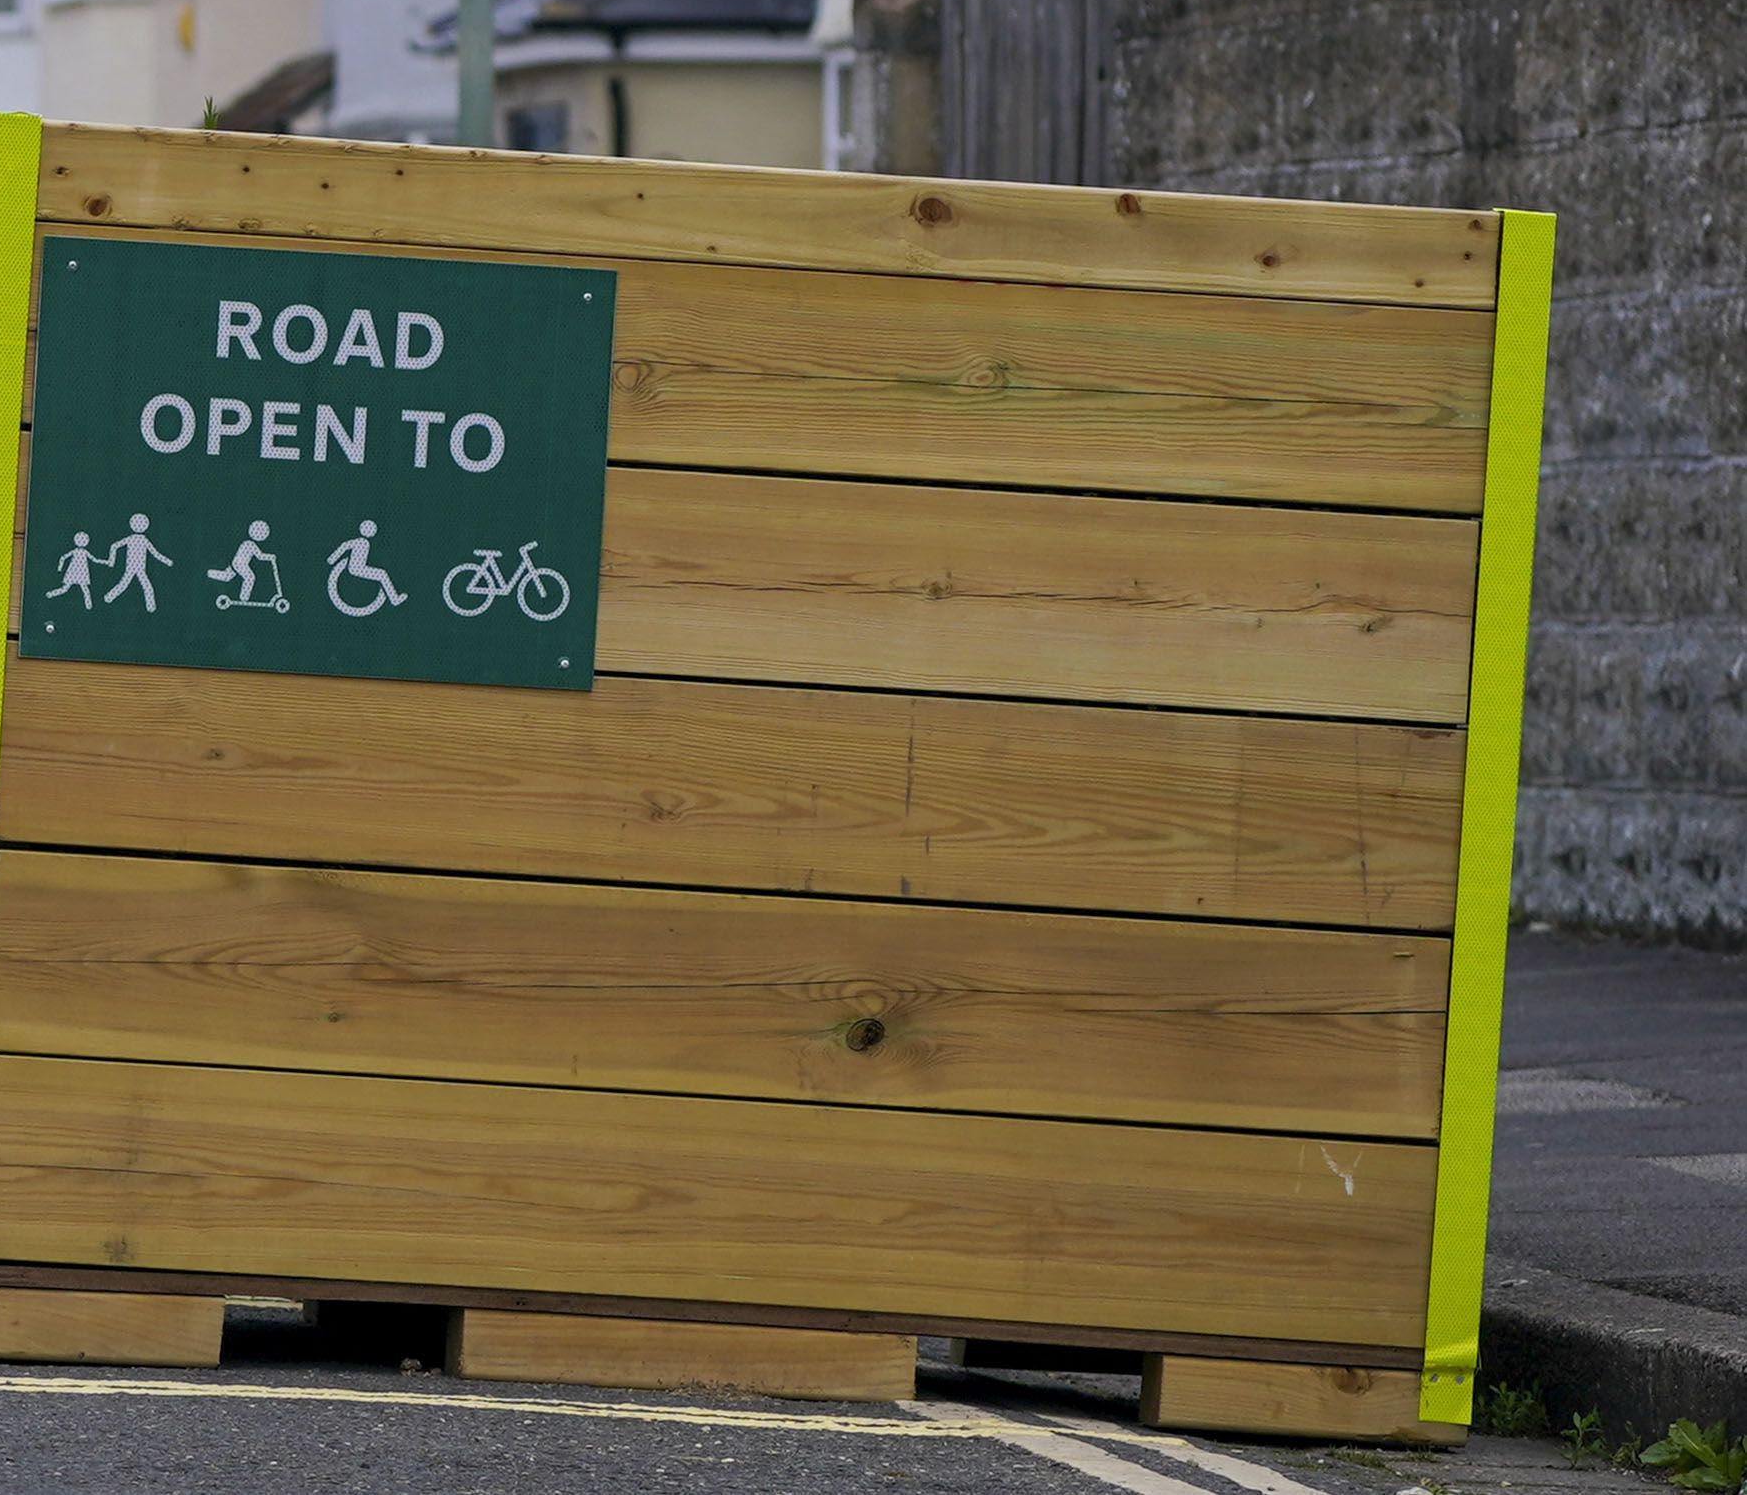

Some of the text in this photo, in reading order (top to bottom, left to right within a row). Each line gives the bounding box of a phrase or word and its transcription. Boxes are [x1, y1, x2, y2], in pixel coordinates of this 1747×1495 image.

[216, 300, 444, 370] ROAD
[140, 393, 505, 473] OPEN TO
